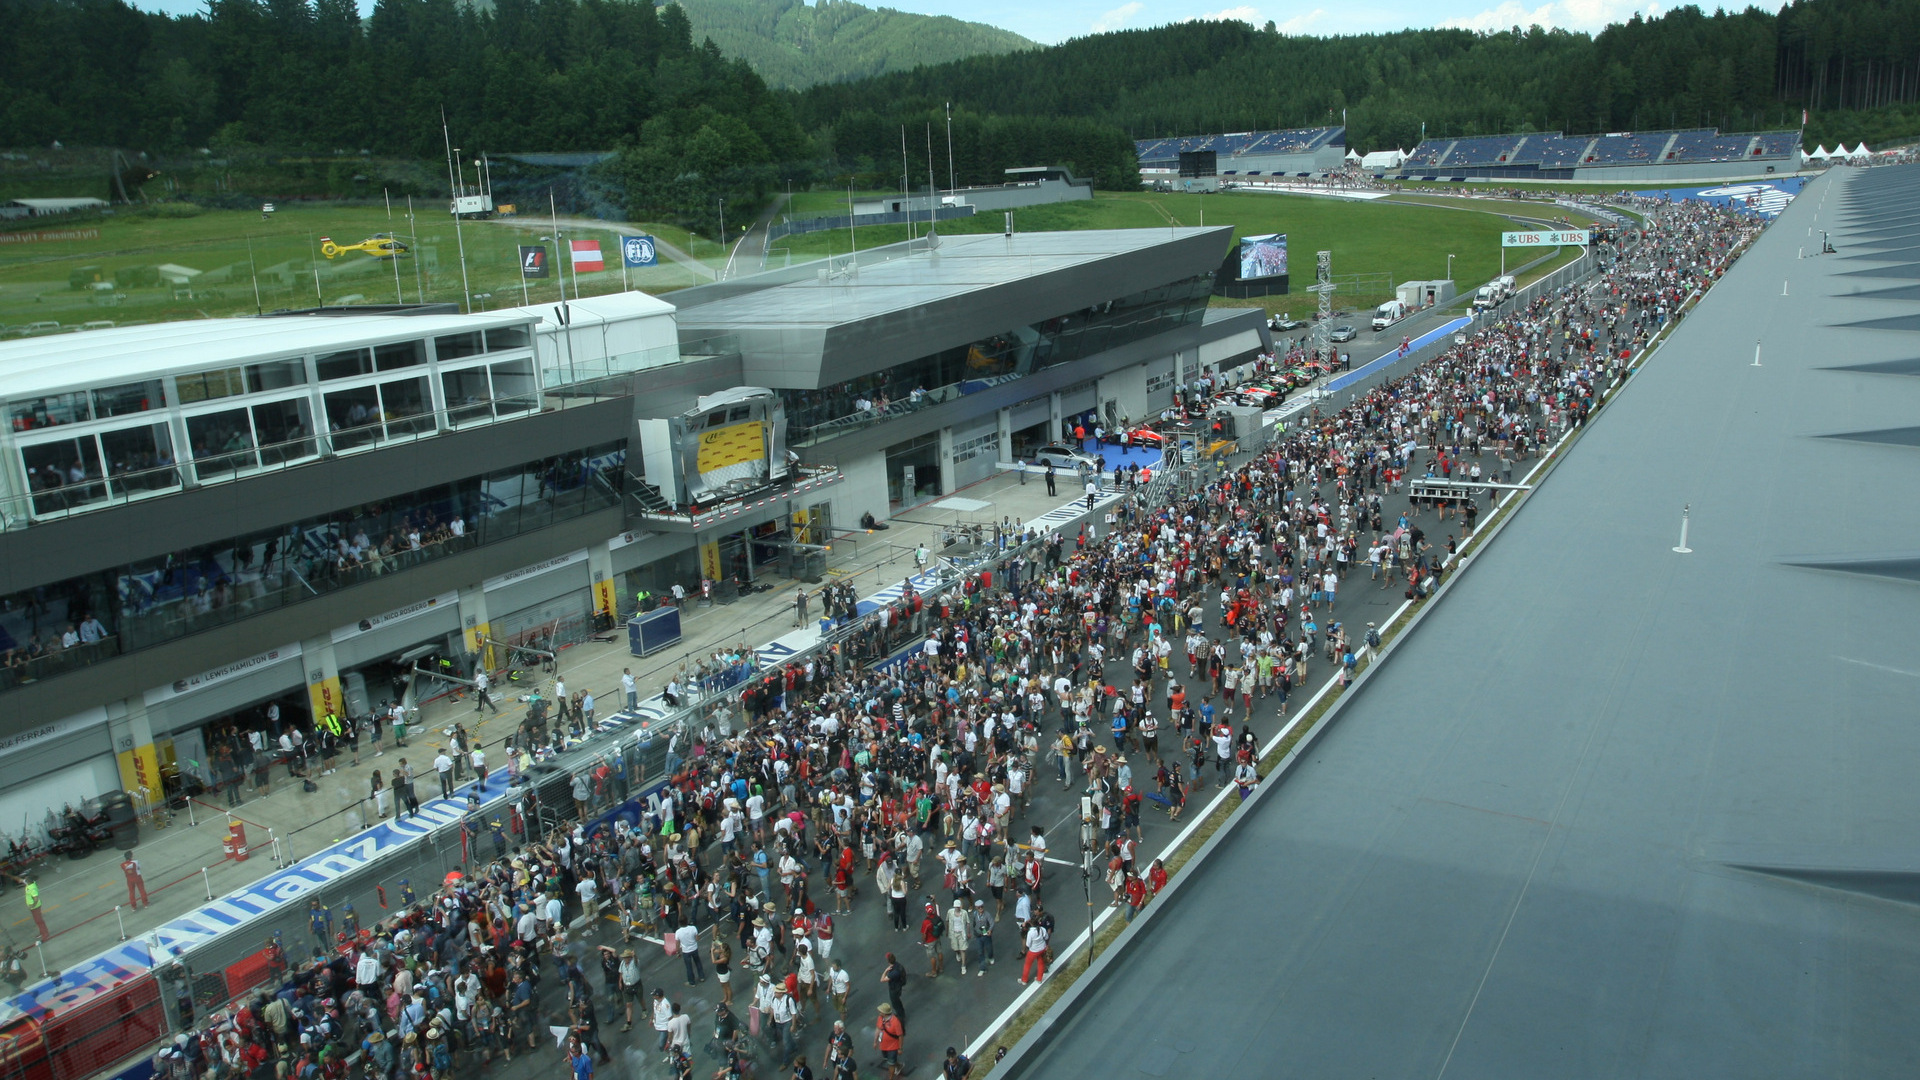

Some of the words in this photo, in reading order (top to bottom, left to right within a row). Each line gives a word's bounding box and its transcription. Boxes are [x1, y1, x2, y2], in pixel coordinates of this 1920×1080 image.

[1518, 234, 1540, 244] UBS
[1561, 233, 1583, 242] UBS
[384, 612, 398, 622] NICO
[400, 602, 428, 615] ROSBERG
[205, 668, 229, 682] LEWIS
[230, 655, 267, 672] HAMILTON
[16, 726, 55, 744] FERRARI
[121, 738, 132, 748] 10
